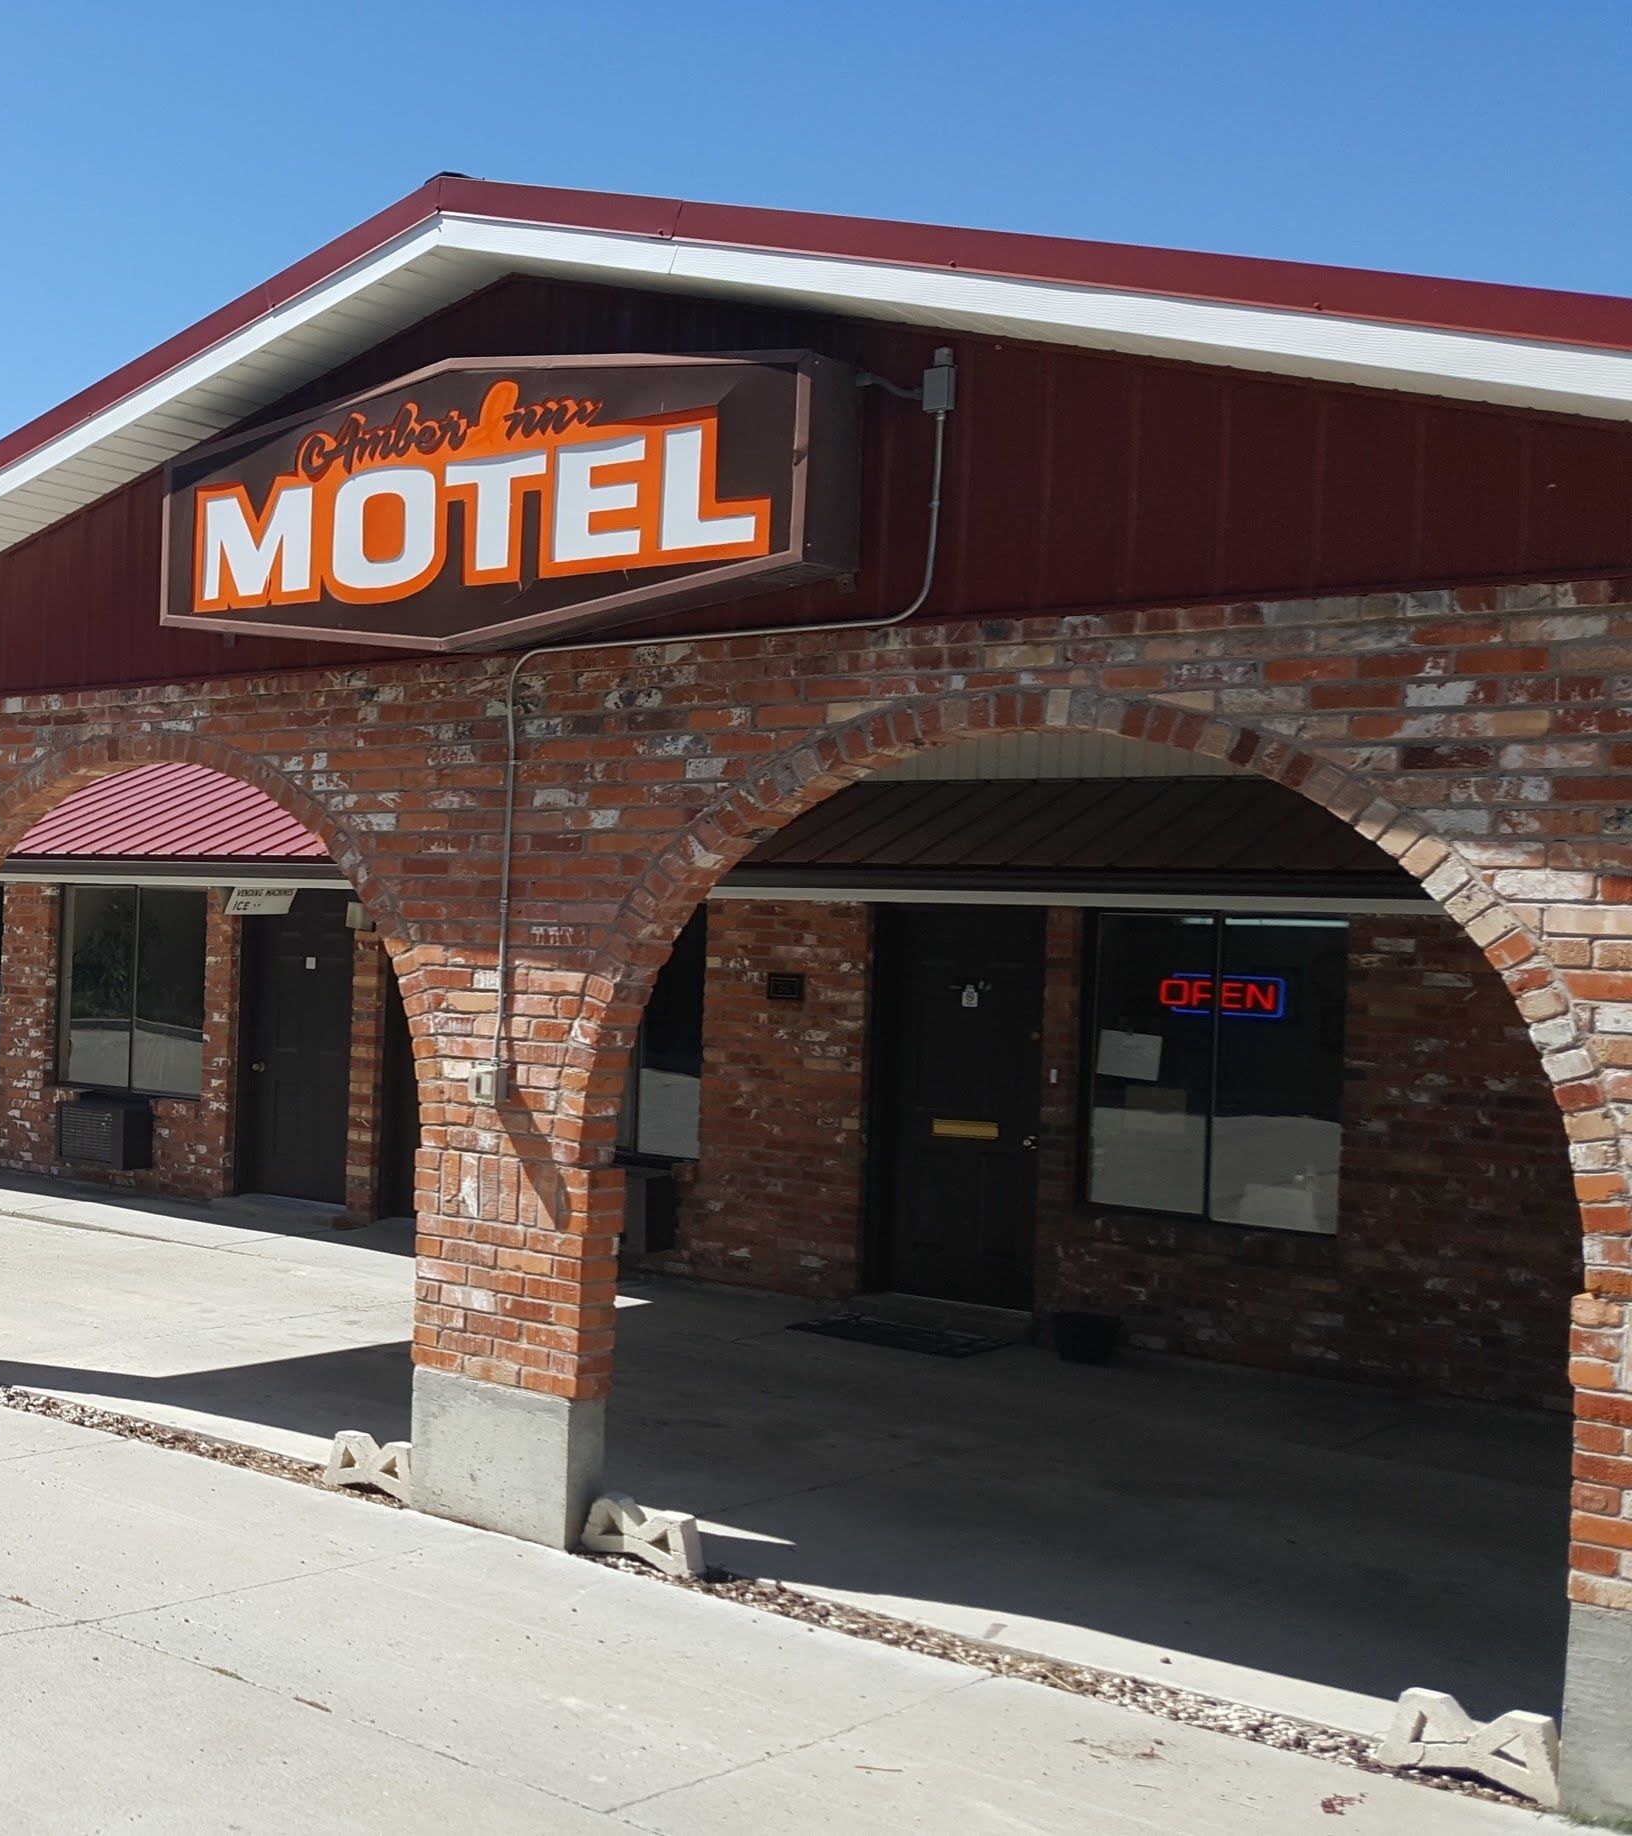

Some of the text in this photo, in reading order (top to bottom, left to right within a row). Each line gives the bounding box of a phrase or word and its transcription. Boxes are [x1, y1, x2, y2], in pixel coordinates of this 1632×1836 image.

[298, 402, 470, 481] Amber
[202, 424, 756, 602] MOTEL
[232, 901, 250, 911] ICE
[1159, 979, 1276, 1011] OPEN
